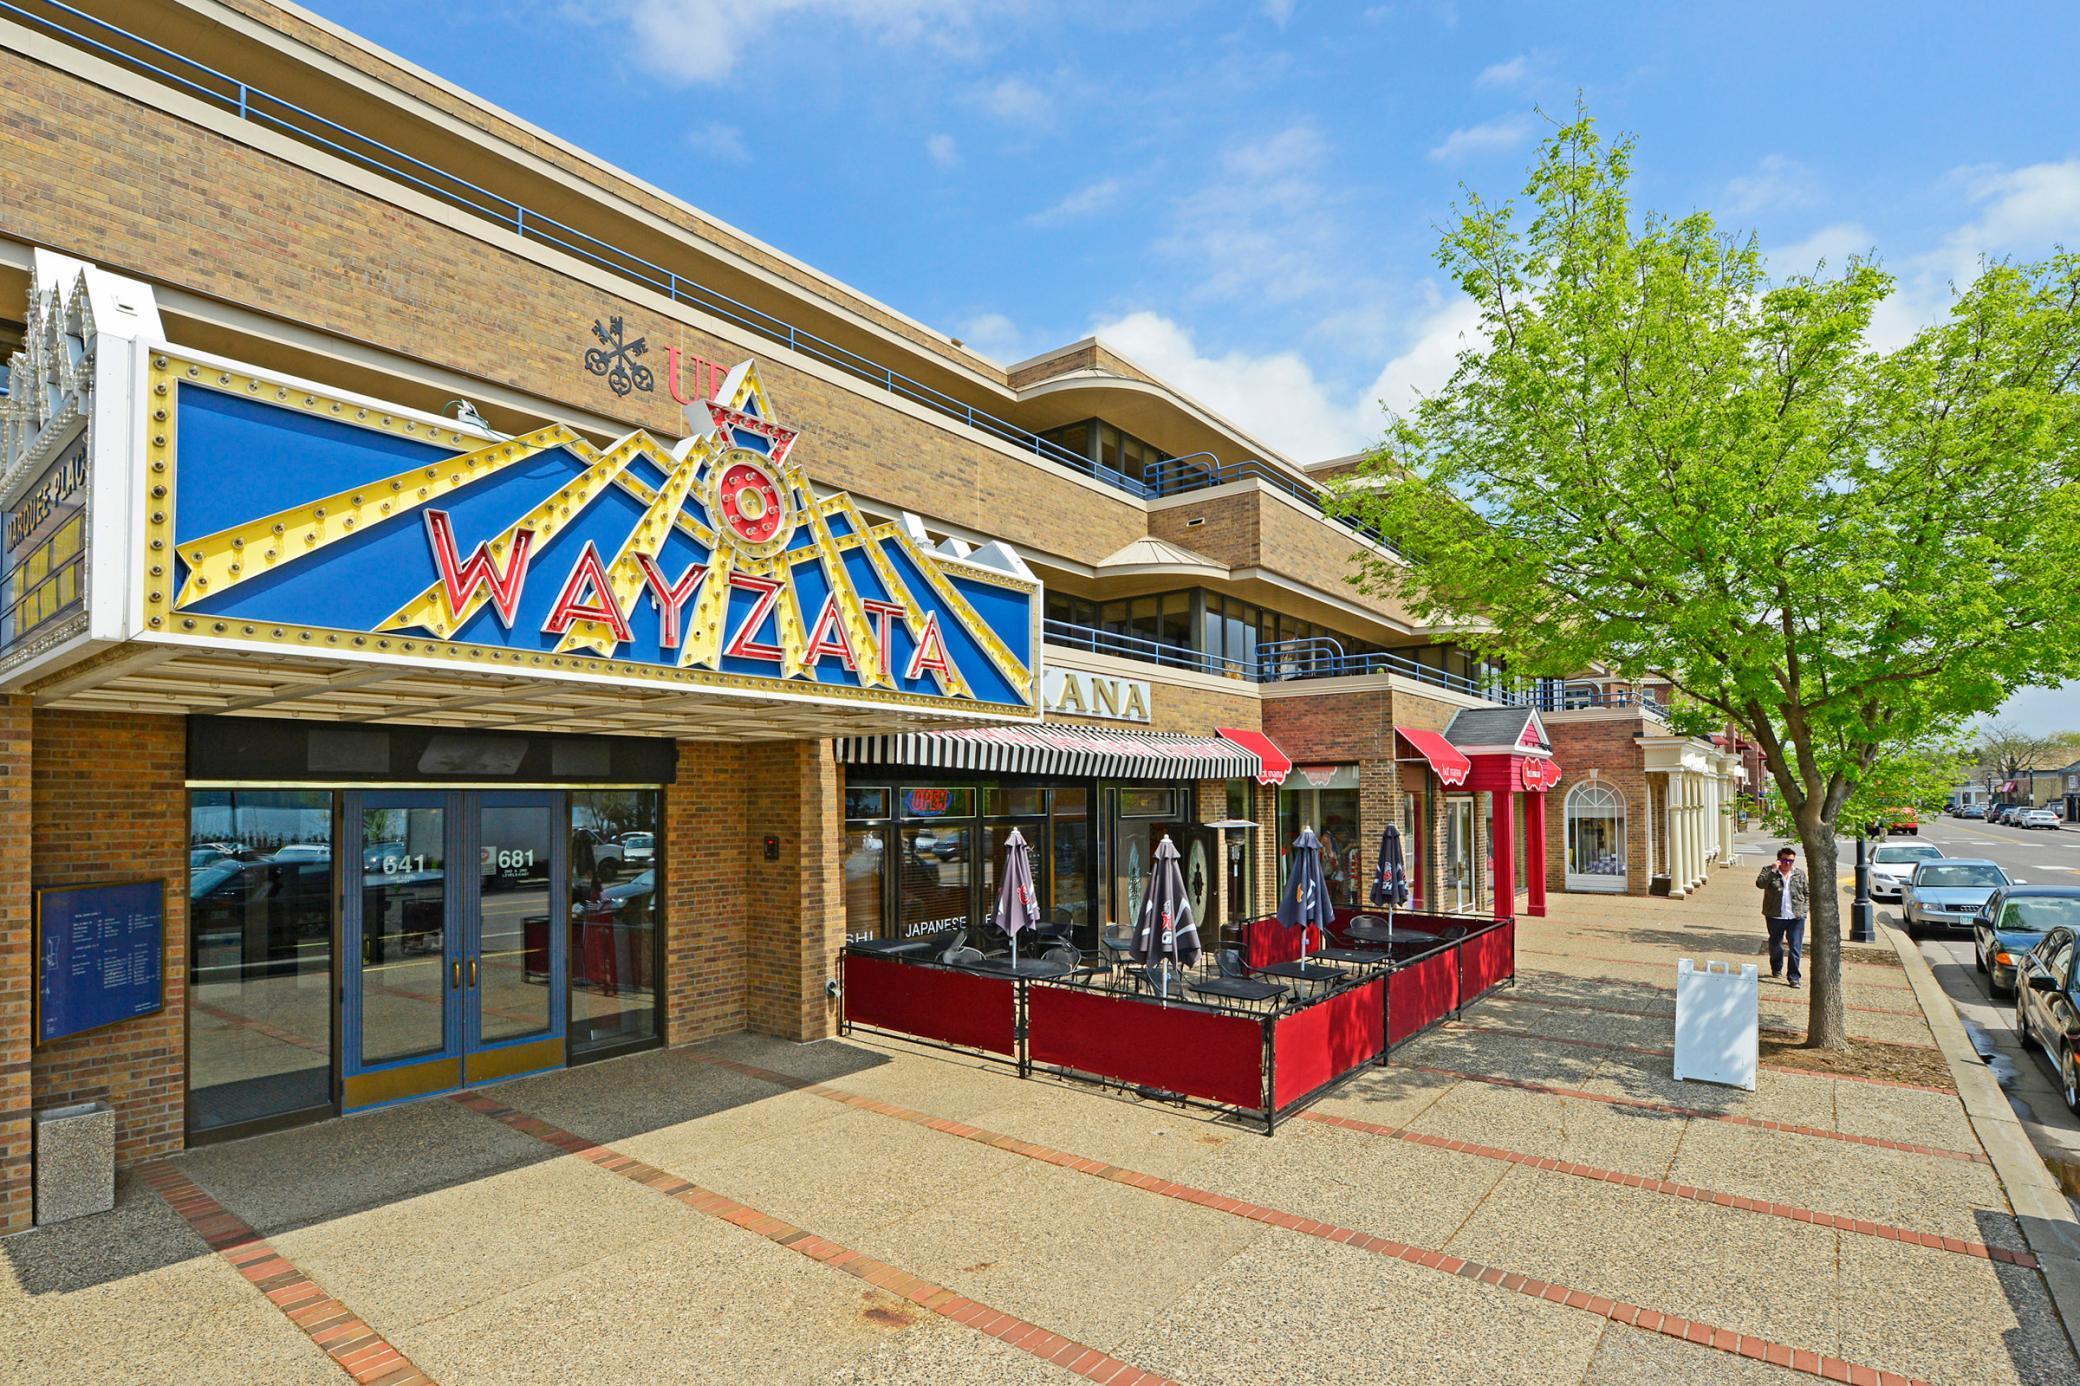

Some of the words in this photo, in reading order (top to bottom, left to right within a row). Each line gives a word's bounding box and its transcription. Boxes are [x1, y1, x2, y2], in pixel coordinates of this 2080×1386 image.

[7, 482, 51, 554] MARQUEE
[422, 508, 953, 683] WAYZATA
[1043, 669, 1150, 718] ANA
[912, 788, 947, 810] OPEN
[382, 854, 424, 875] 641
[498, 849, 534, 868] 681
[905, 916, 966, 938] JAPANESE
